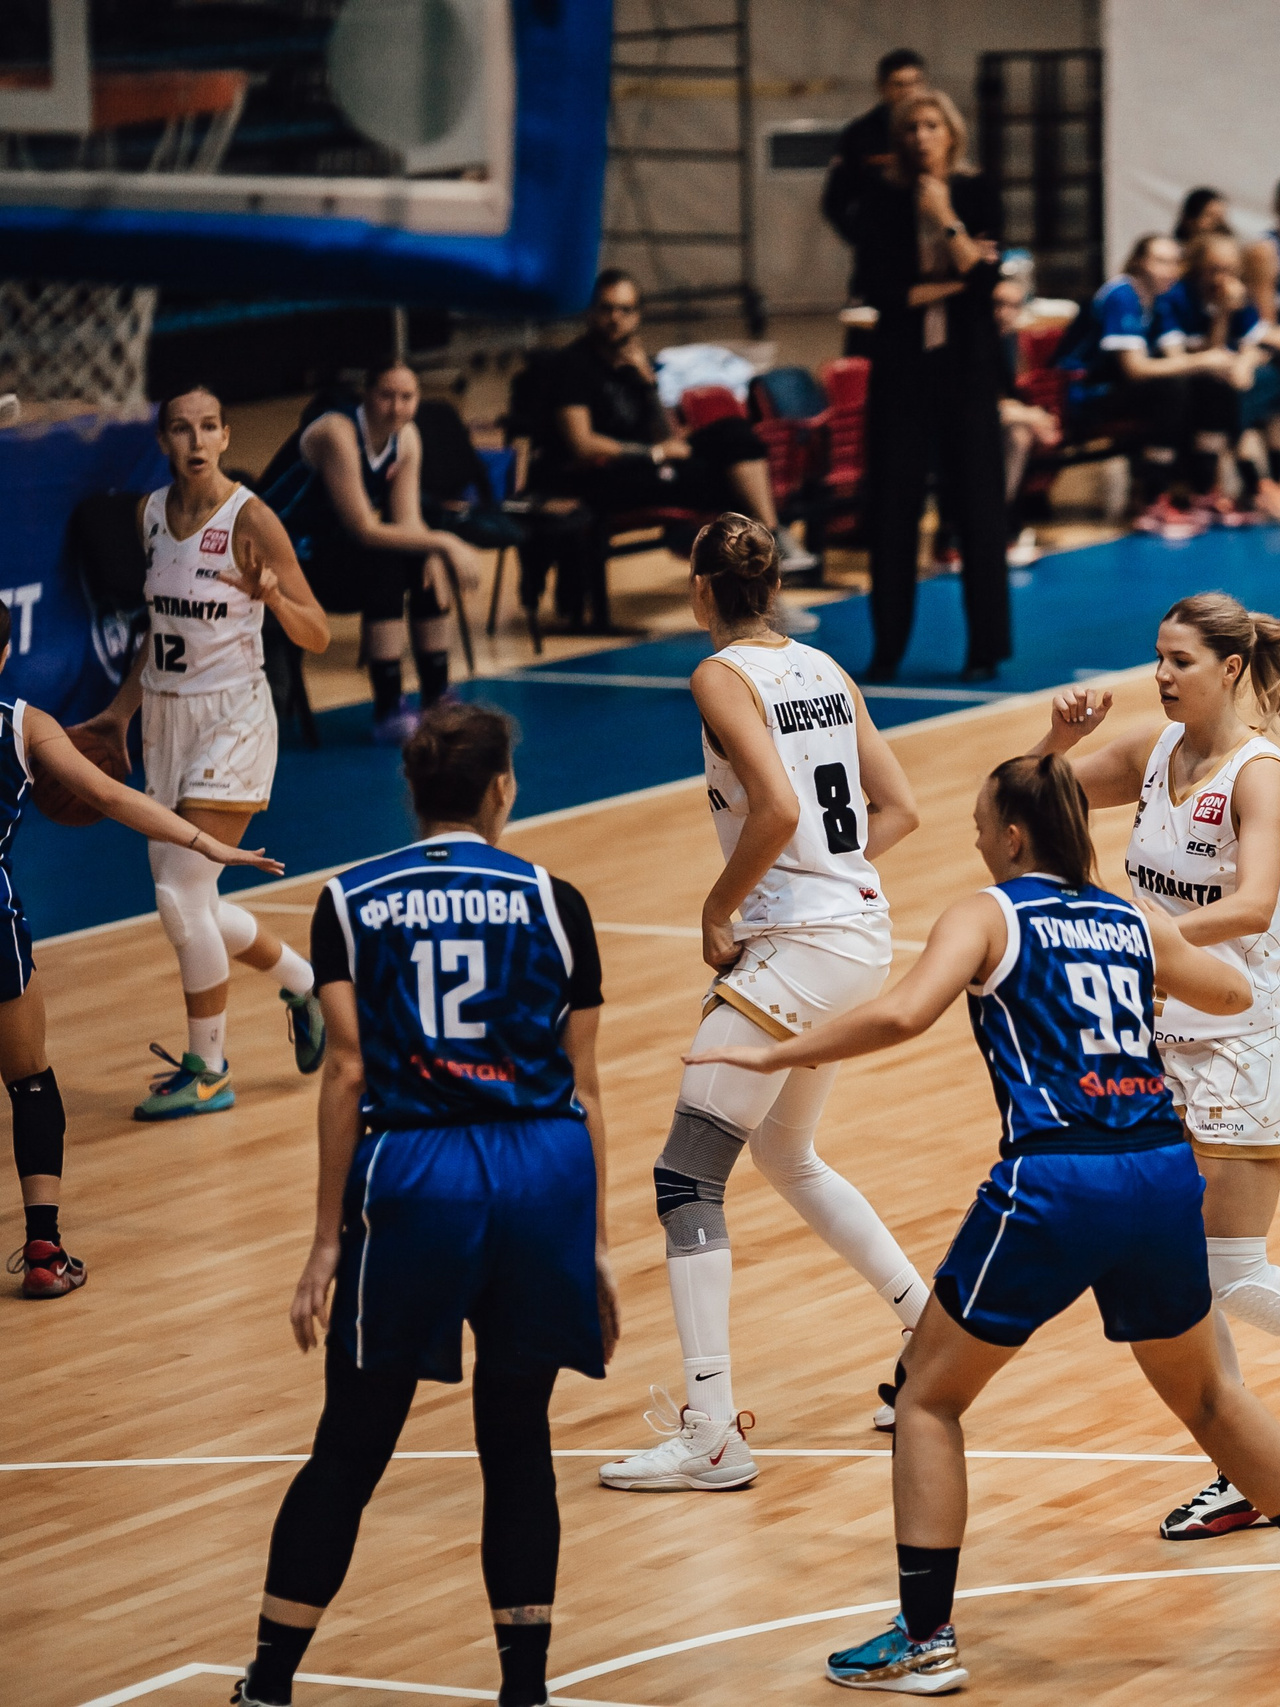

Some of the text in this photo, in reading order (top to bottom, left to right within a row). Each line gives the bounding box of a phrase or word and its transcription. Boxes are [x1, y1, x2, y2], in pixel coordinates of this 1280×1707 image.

[153, 633, 187, 673] 12
[773, 692, 853, 735] ШЕВЧЕНКО
[813, 762, 861, 855] 8
[1194, 807, 1221, 820] BET
[1200, 795, 1224, 809] FON
[360, 889, 530, 929] ФЕДОТОВА
[1029, 916, 1147, 958] ТУМАНОВА
[410, 939, 487, 1039] 12
[1064, 962, 1152, 1059] 99
